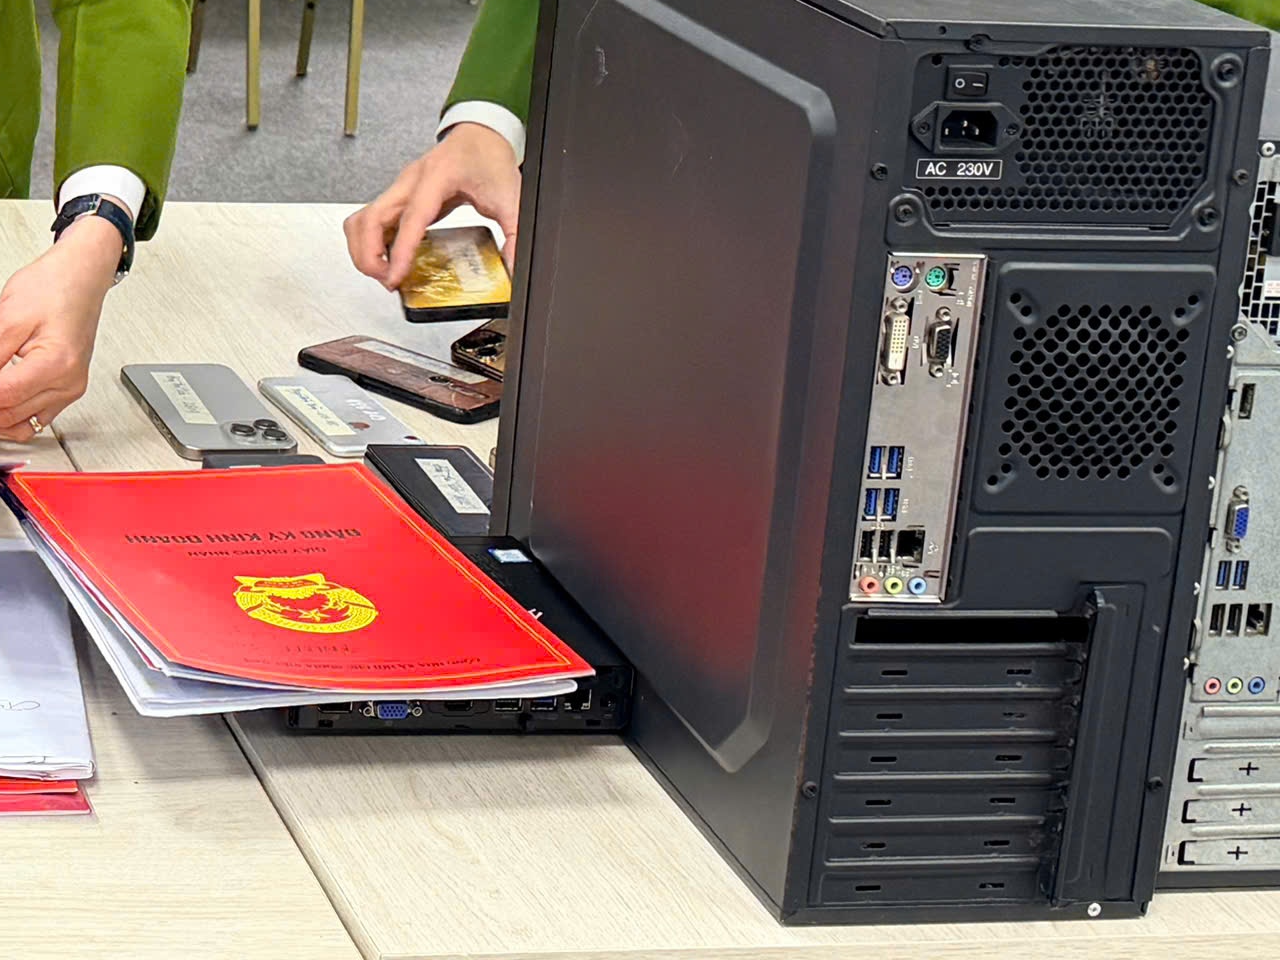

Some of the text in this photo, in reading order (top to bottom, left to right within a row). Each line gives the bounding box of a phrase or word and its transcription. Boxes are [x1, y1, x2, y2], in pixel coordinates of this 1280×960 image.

[925, 162, 993, 177] AC 230V
[123, 533, 203, 545] DOANH
[206, 532, 262, 544] KINH
